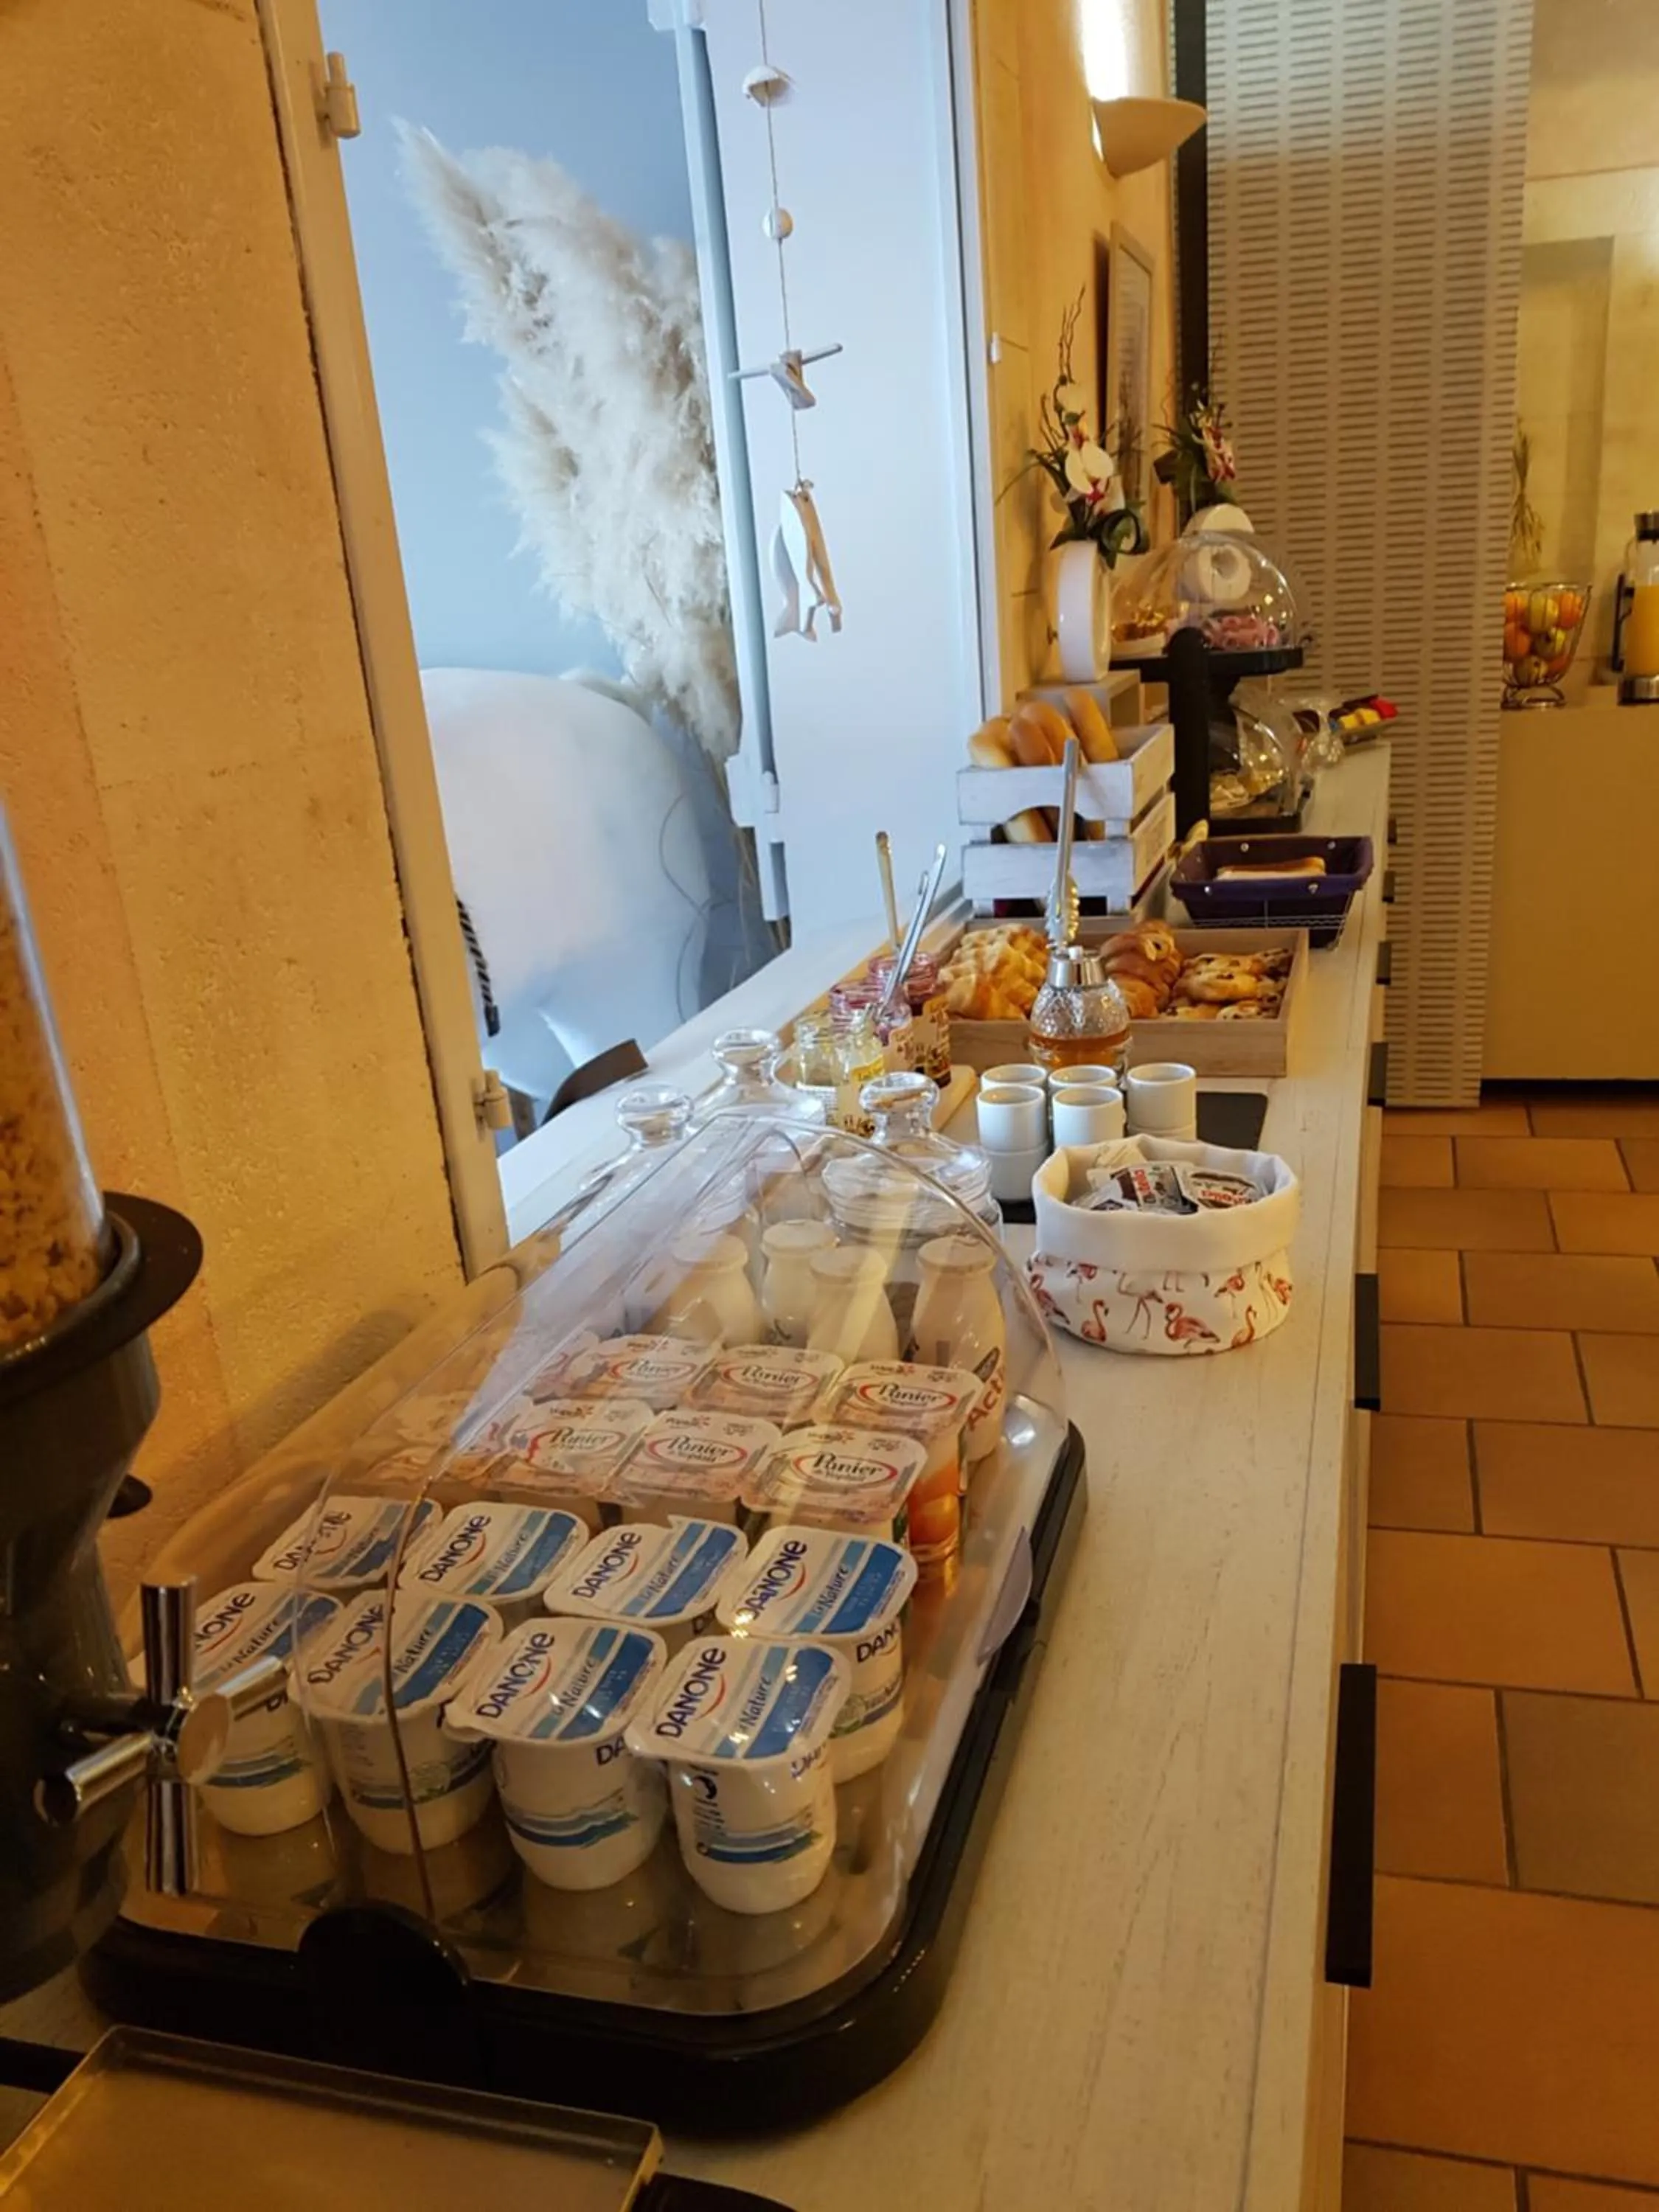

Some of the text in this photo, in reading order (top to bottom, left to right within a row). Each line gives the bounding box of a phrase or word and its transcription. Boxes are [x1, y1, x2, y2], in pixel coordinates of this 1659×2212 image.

[813, 1450, 883, 1475] Panier
[821, 1566, 849, 1610] Nature
[393, 1627, 434, 1674] Nature
[561, 1655, 597, 1708] Nature
[738, 1675, 773, 1728] Nature
